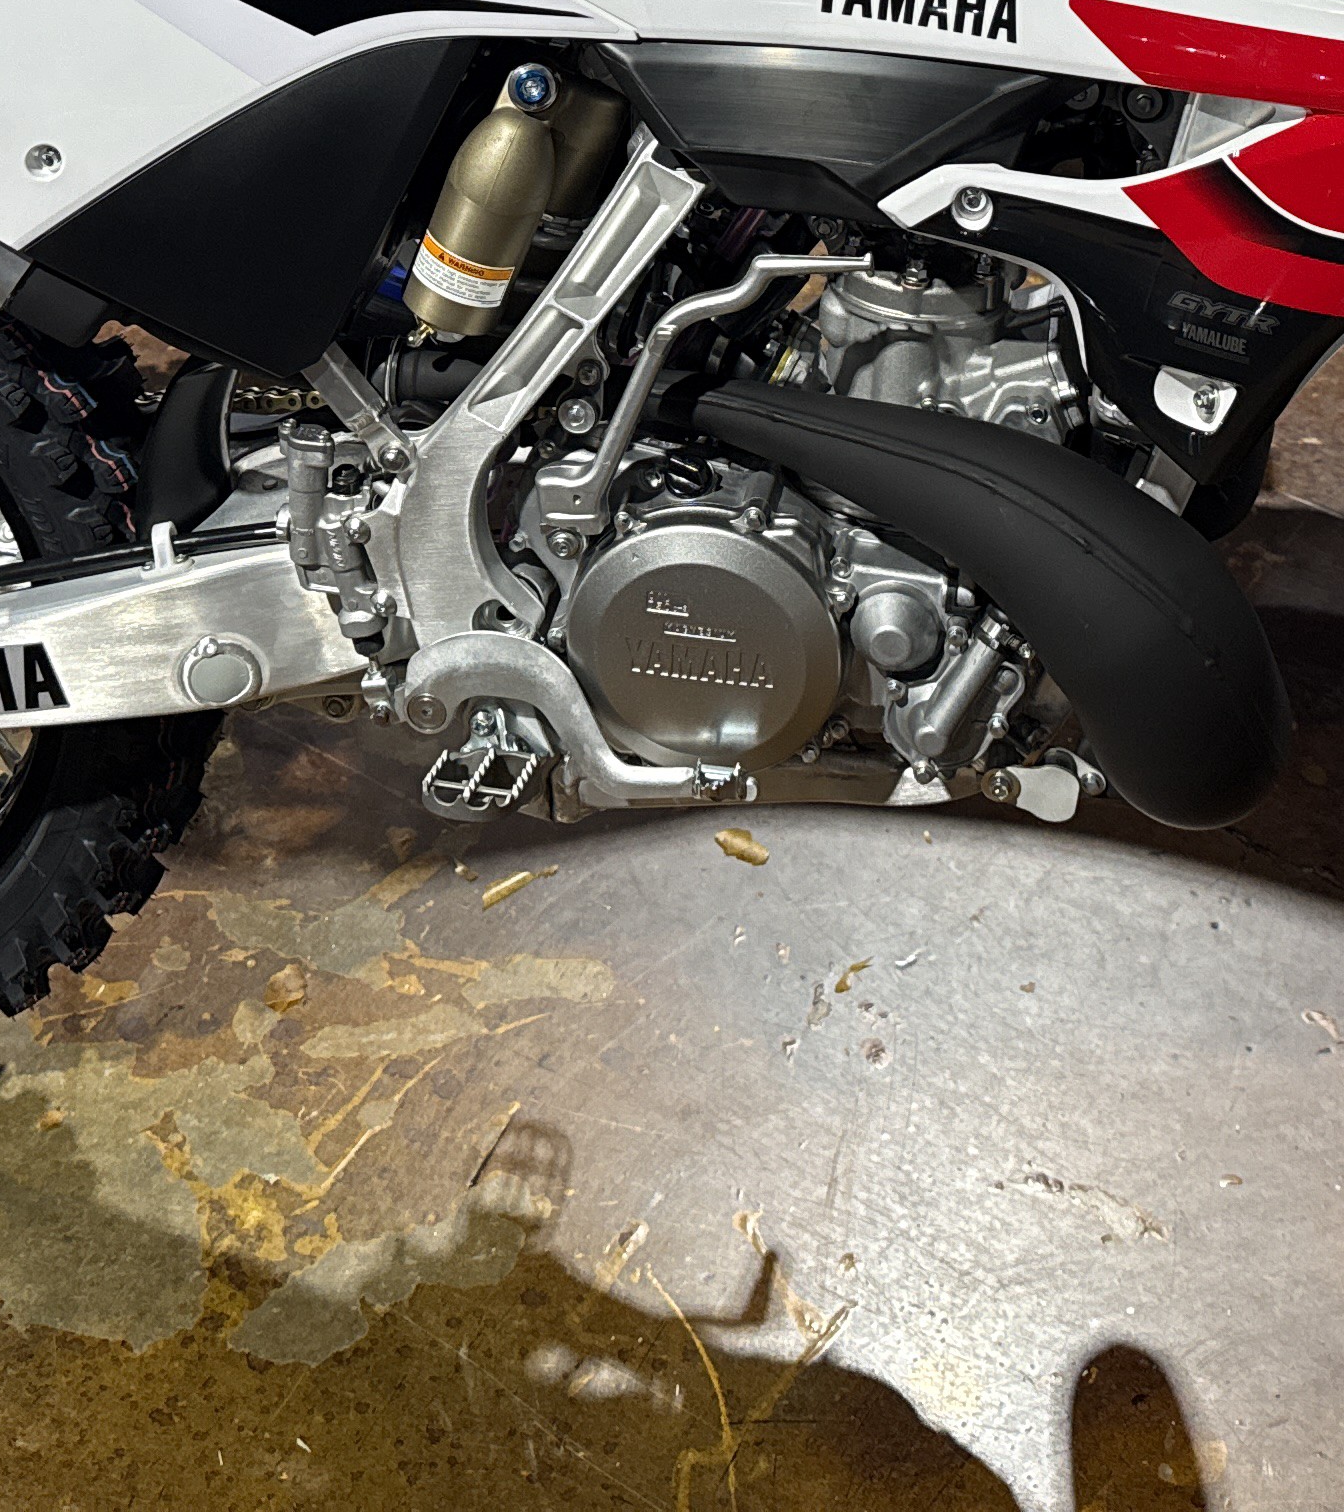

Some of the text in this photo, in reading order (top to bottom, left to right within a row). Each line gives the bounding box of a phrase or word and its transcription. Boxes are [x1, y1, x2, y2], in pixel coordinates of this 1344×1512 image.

[1166, 289, 1281, 336] GYTR
[1181, 321, 1248, 356] YAMALUBE
[625, 636, 775, 690] YAMAHA
